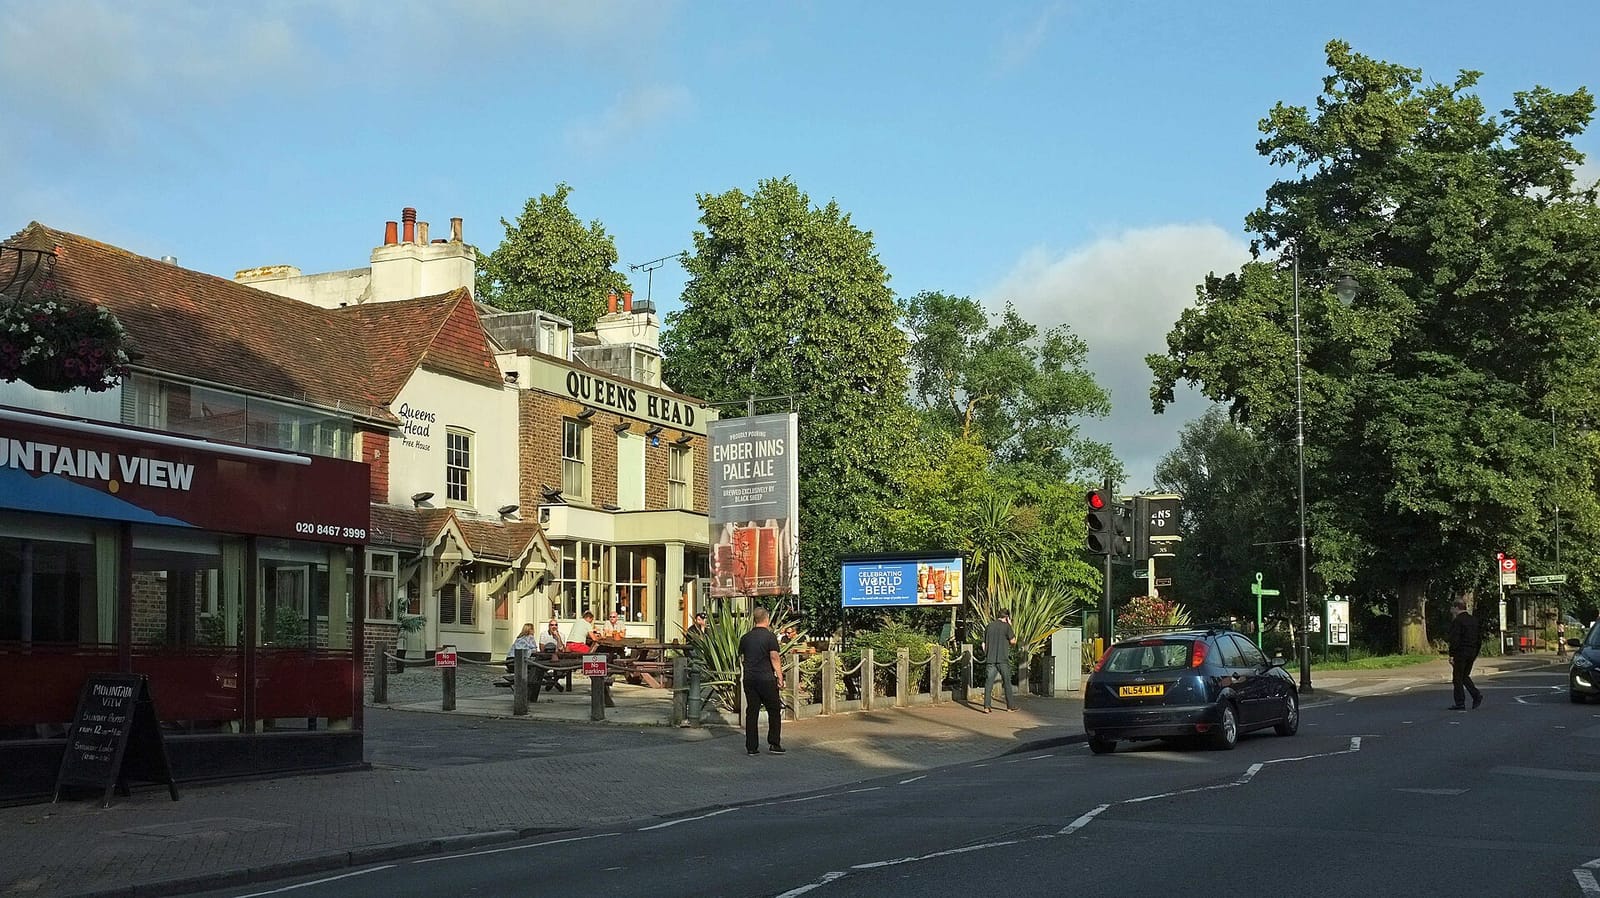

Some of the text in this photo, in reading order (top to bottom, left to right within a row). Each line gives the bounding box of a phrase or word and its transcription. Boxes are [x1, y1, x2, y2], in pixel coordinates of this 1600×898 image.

[566, 370, 695, 427] QUEENS HEAD
[398, 402, 436, 424] Queens
[403, 420, 430, 438] Head
[402, 438, 431, 452] Free House
[713, 438, 784, 462] EMBER INNS
[117, 454, 196, 491] VIEW
[723, 459, 774, 481] PALE ALE
[735, 493, 763, 503] BLACK SHEEP
[742, 486, 768, 495] EXCLUSIVELY
[295, 521, 366, 540] 020 8467 3999
[858, 570, 903, 578] CELEBRATING
[858, 577, 903, 586] WORLD
[865, 586, 896, 595] BEER
[1122, 686, 1142, 695] NL54
